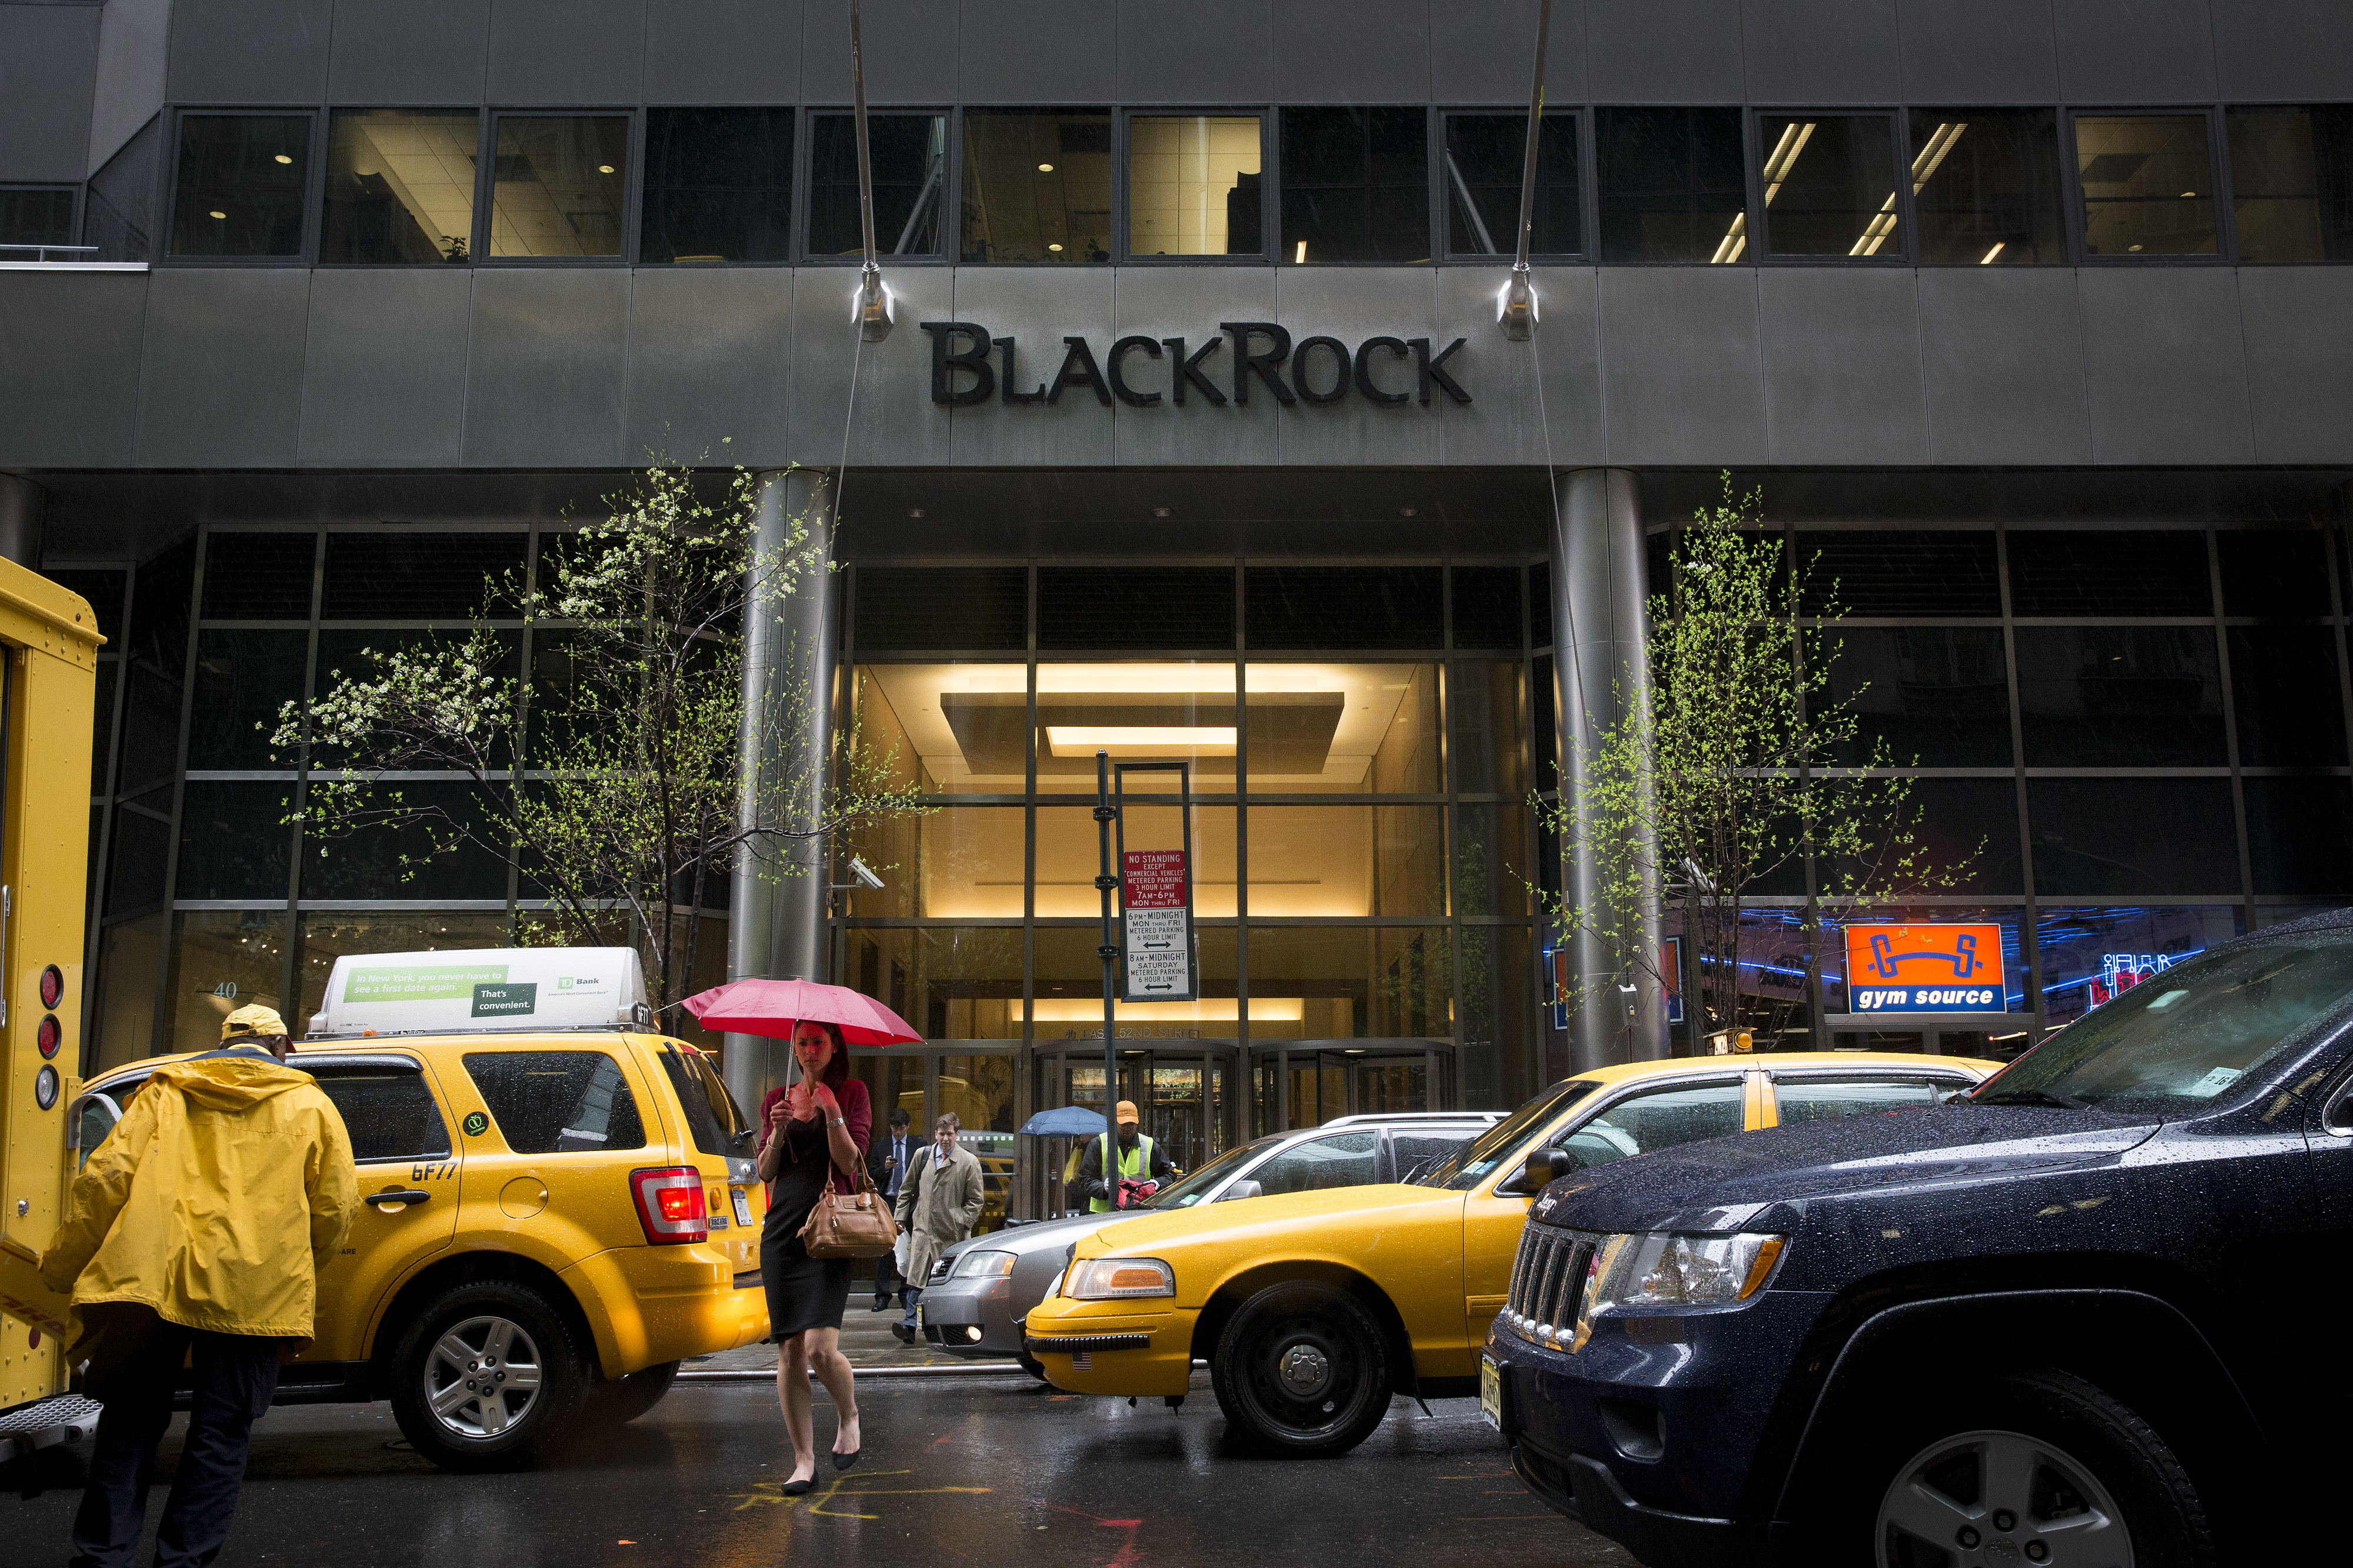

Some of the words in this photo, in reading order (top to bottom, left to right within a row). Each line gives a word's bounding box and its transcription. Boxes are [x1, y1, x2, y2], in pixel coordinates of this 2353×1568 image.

[1143, 855, 1180, 863] STANDING
[393, 974, 415, 983] York,
[418, 975, 435, 983] you
[466, 972, 489, 980] have
[560, 978, 572, 987] TD
[214, 982, 236, 999] 40
[429, 985, 458, 993] again.
[481, 990, 506, 998] That's
[1859, 990, 1907, 1009] gym
[1915, 990, 1994, 1005] source
[638, 1006, 648, 1024] 6F77
[1082, 1029, 1105, 1039] EAS
[1119, 1027, 1152, 1038] 52ND
[1158, 1027, 1202, 1040] STREET
